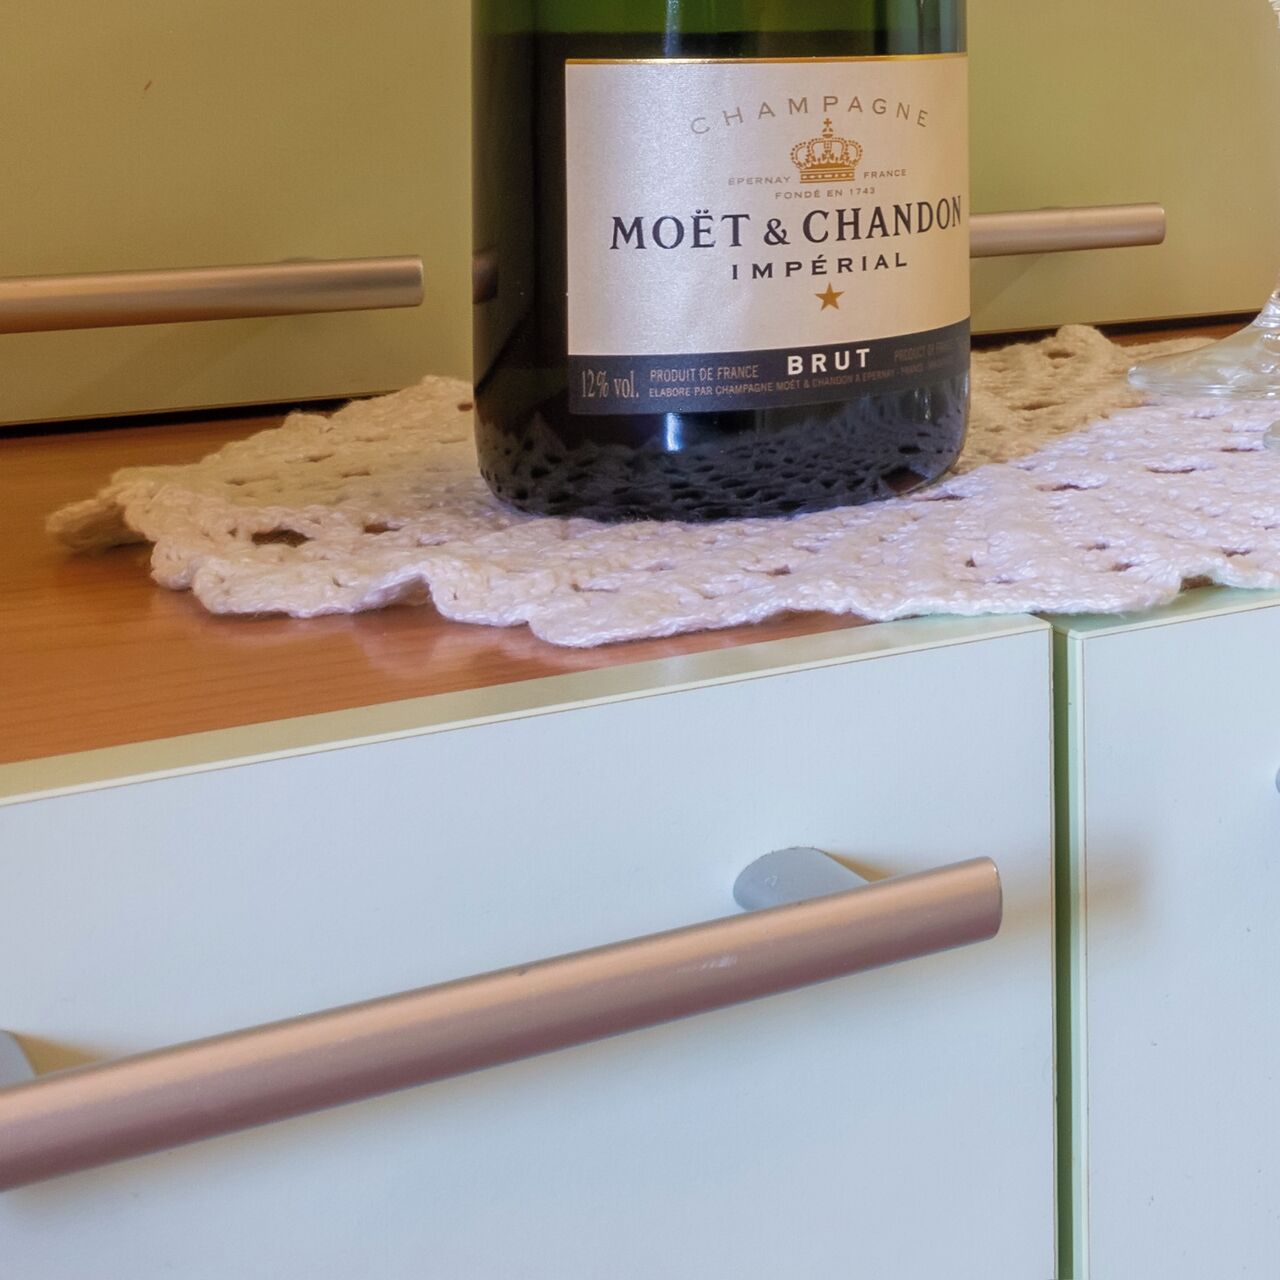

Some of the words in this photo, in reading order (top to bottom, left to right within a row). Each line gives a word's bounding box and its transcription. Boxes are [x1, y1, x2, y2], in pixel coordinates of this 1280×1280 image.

[690, 96, 928, 135] CHAMPAGNE
[863, 168, 906, 179] FRANCE
[775, 189, 820, 199] FONDÉ
[827, 188, 843, 198] EN
[849, 186, 875, 197] 1743
[610, 209, 750, 250] MOËT
[764, 218, 790, 246] &
[803, 195, 962, 244] CHANDON
[732, 252, 907, 280] IMPÉRIAL
[650, 368, 696, 382] PRODUIT
[700, 367, 713, 381] DE
[717, 365, 760, 380] FRANCE
[787, 348, 870, 375] BRUT
[581, 369, 609, 398] 12%
[614, 370, 640, 399] vol.
[649, 386, 690, 398] ELABORE
[694, 385, 713, 396] PAR
[715, 382, 774, 396] CHAMPAGNE
